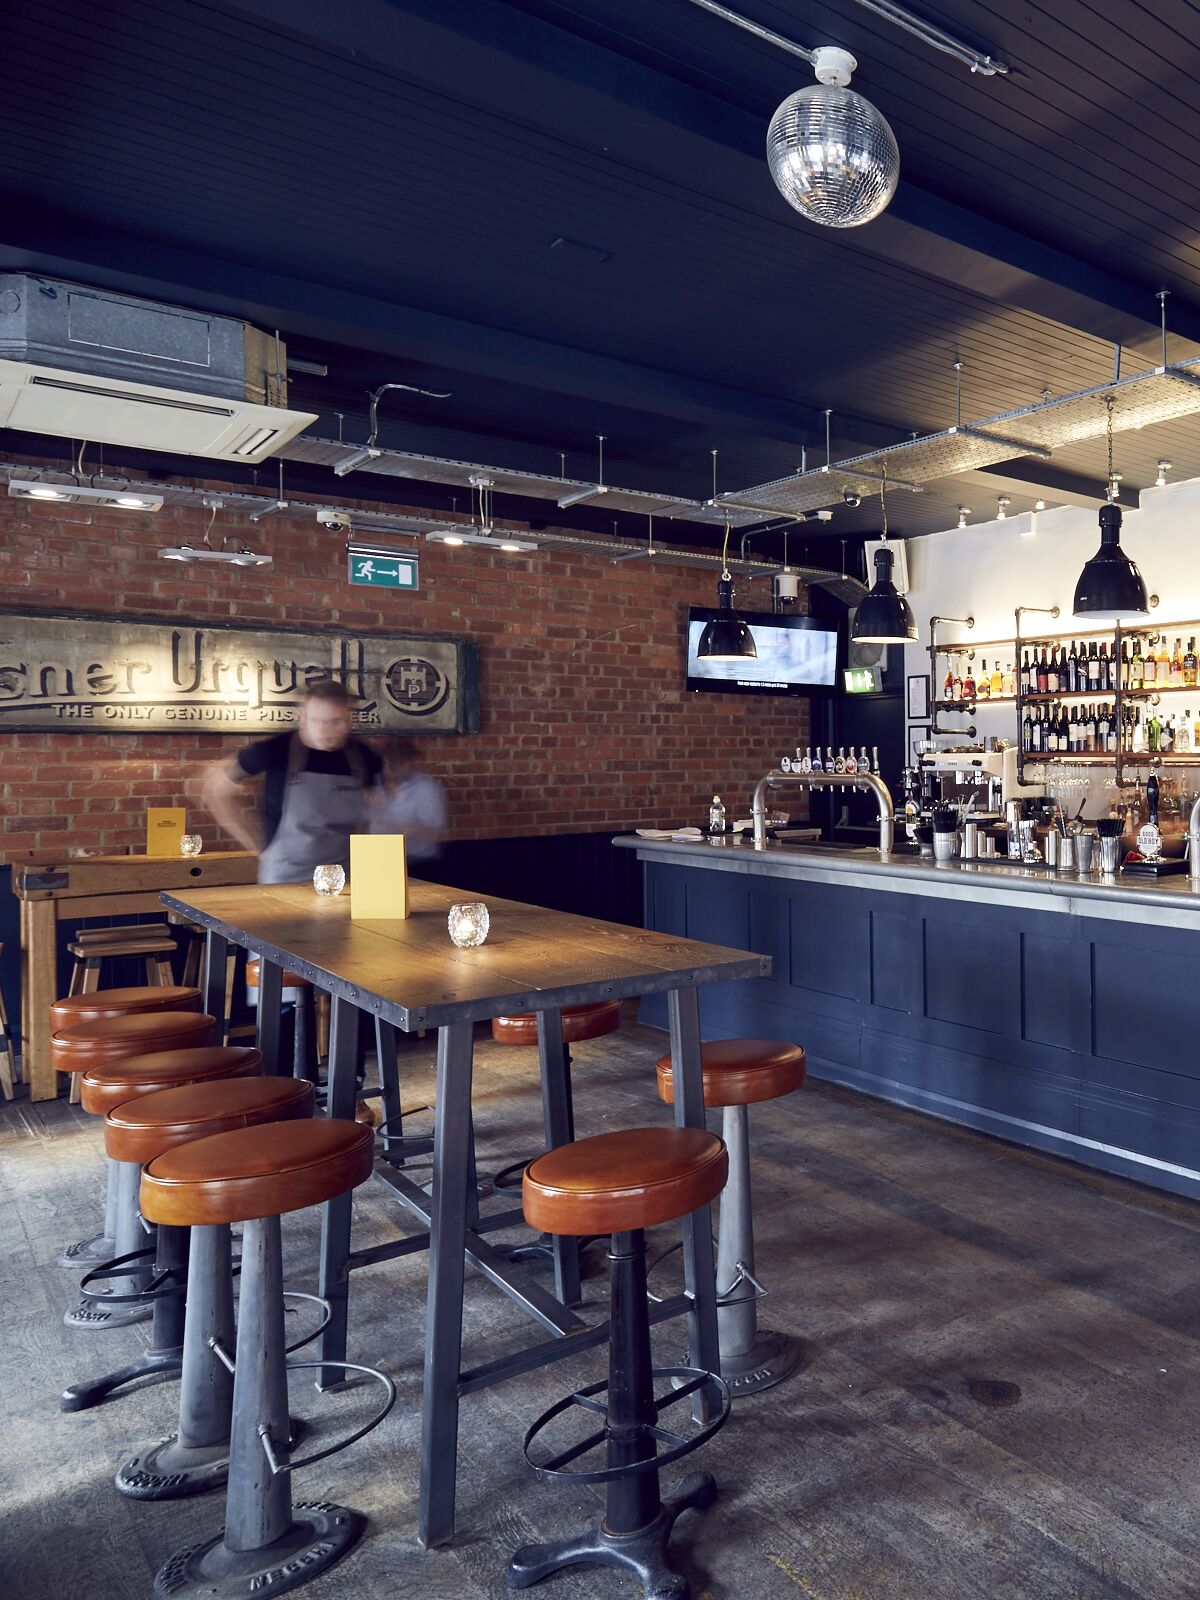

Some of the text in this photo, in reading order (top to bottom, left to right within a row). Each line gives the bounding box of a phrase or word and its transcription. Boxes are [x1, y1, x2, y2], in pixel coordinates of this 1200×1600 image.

[171, 630, 367, 710] Urquell
[52, 703, 95, 718] THE
[104, 704, 154, 720] ONLY
[164, 707, 248, 721] GENUINE
[350, 711, 382, 725] EER
[1148, 837, 1159, 845] BOY
